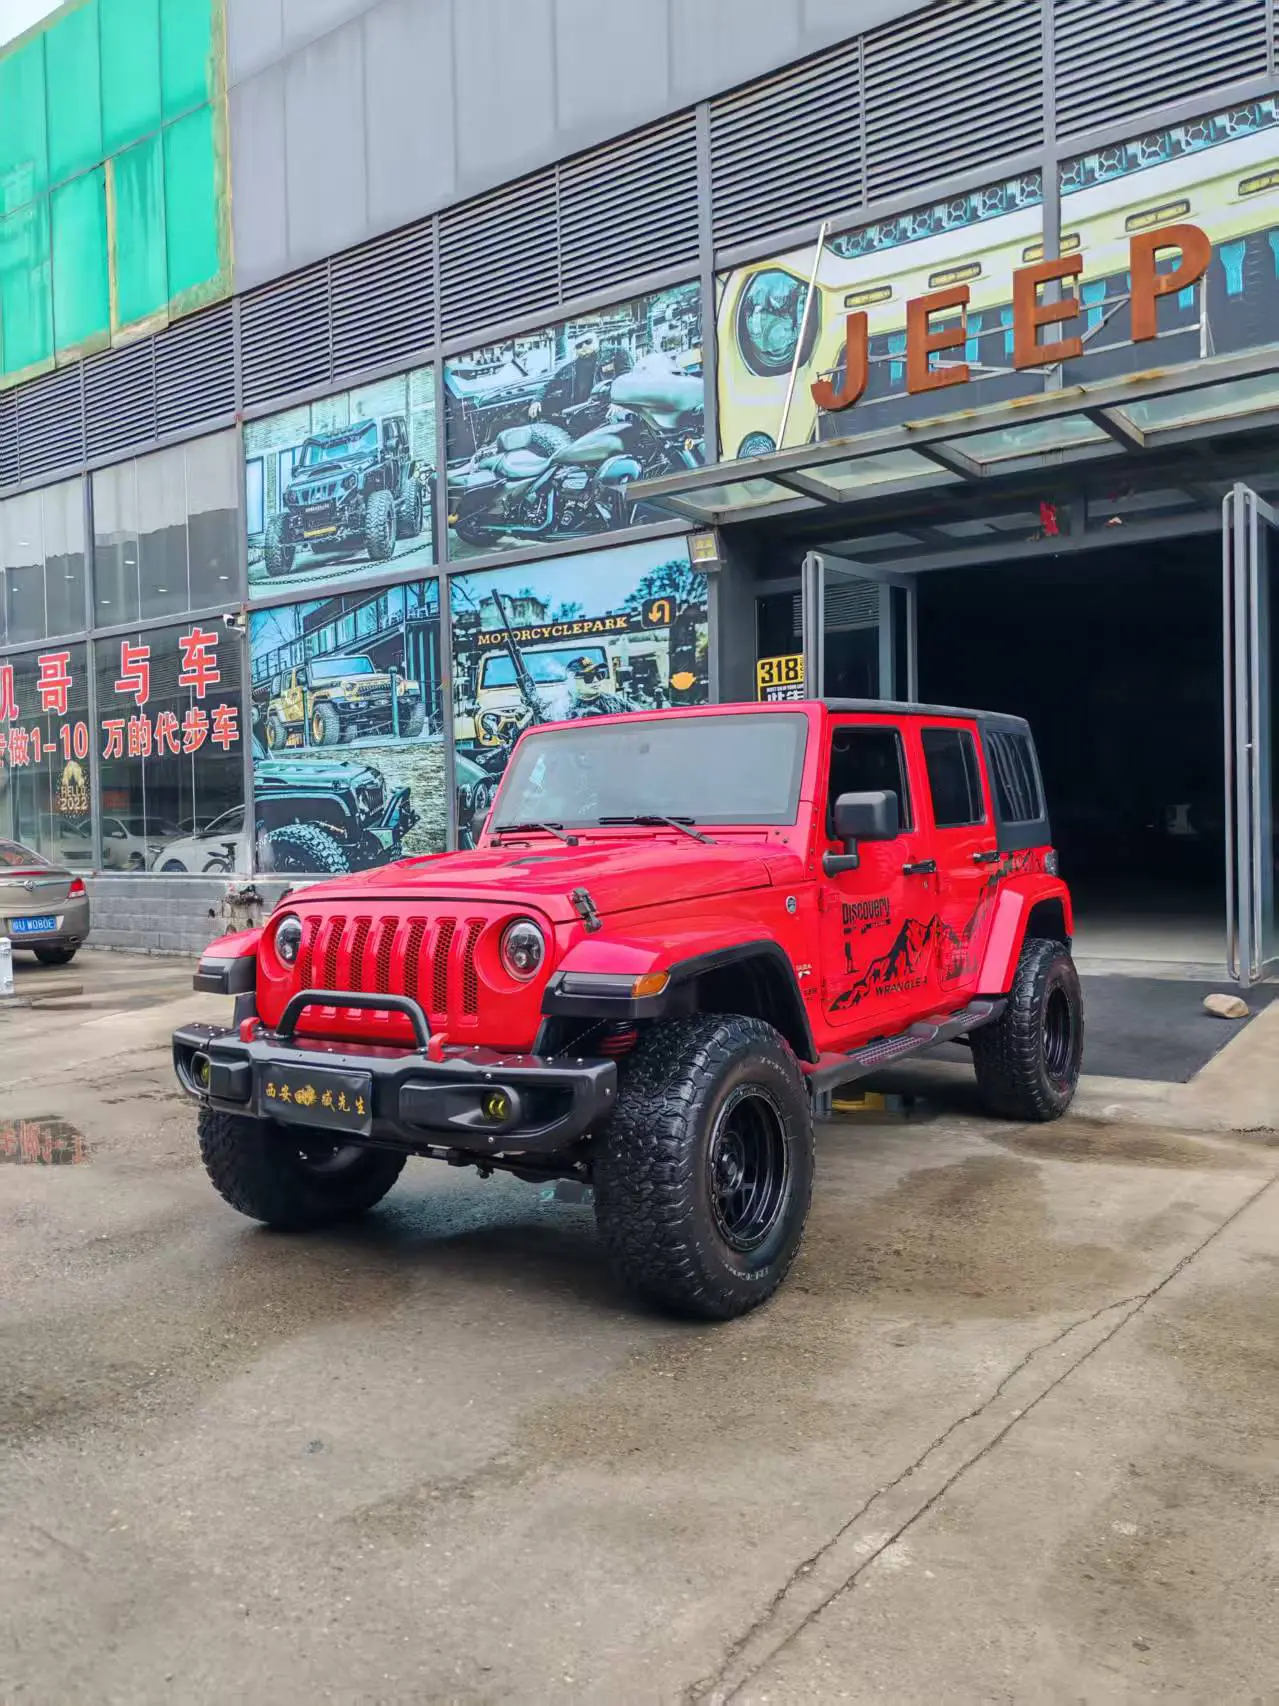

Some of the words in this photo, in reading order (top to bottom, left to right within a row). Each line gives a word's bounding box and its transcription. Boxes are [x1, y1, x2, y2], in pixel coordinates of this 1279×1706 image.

[811, 223, 1211, 411] JEEP
[478, 616, 628, 646] MOTORCYCLEPARK
[760, 658, 799, 684] 318
[60, 797, 88, 811] 2022
